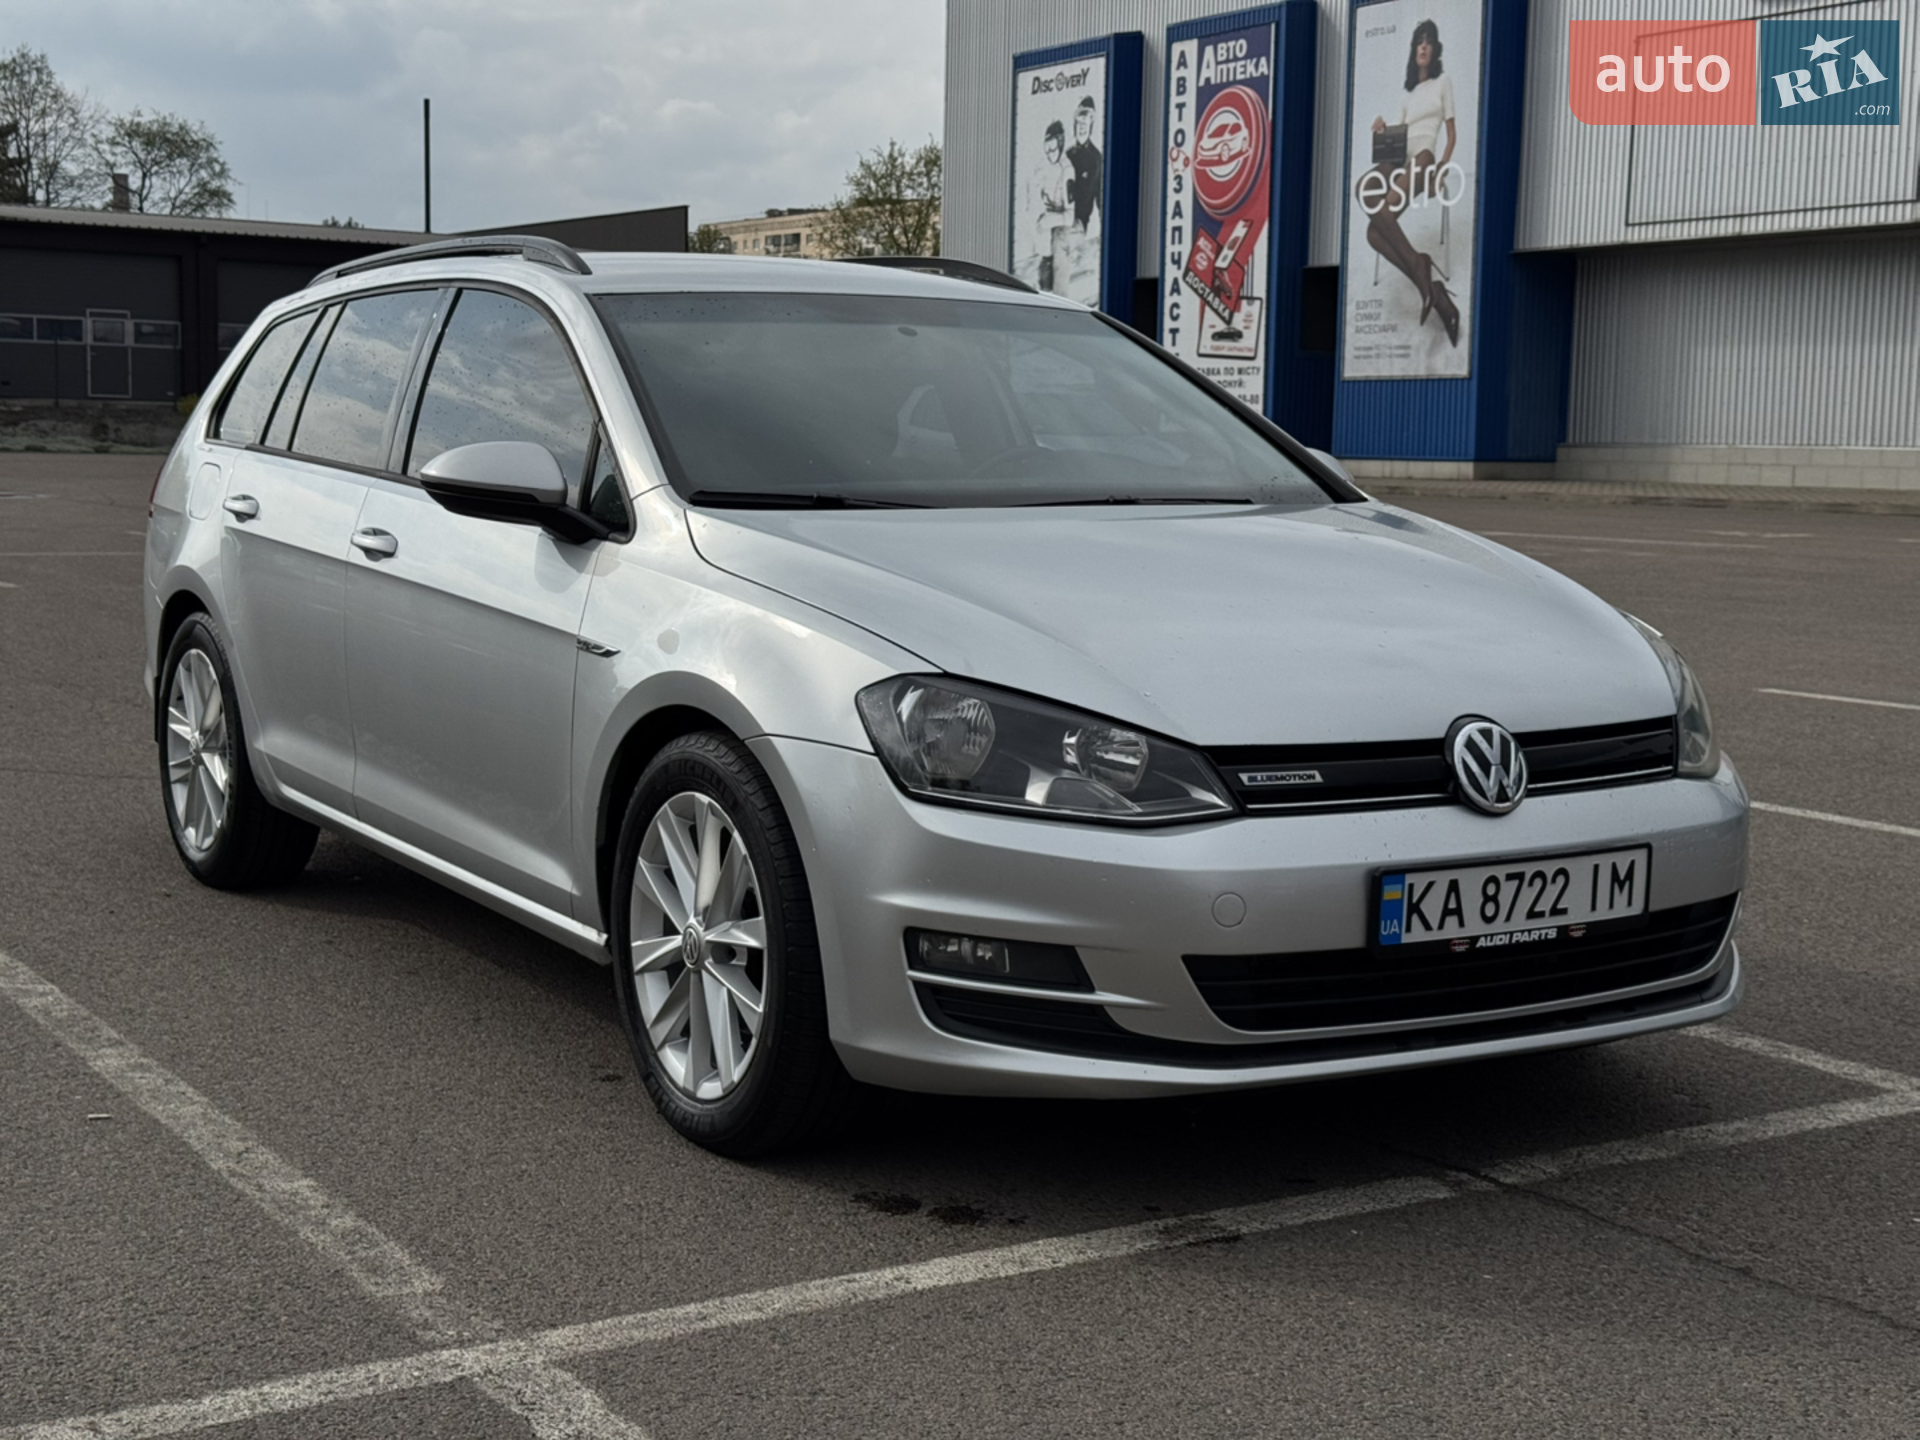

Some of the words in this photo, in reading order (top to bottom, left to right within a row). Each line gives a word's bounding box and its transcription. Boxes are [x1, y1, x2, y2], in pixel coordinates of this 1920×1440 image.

[1358, 157, 1466, 215] estro
[1186, 270, 1231, 322] ДОСТАВКА
[1247, 772, 1317, 784] BLUEMOTION
[1380, 918, 1400, 936] UA
[1404, 878, 1466, 934] KA
[1479, 866, 1571, 925] 8722
[1590, 858, 1636, 913] IM
[1475, 933, 1510, 949] AUDI
[1511, 928, 1558, 944] PARTS
